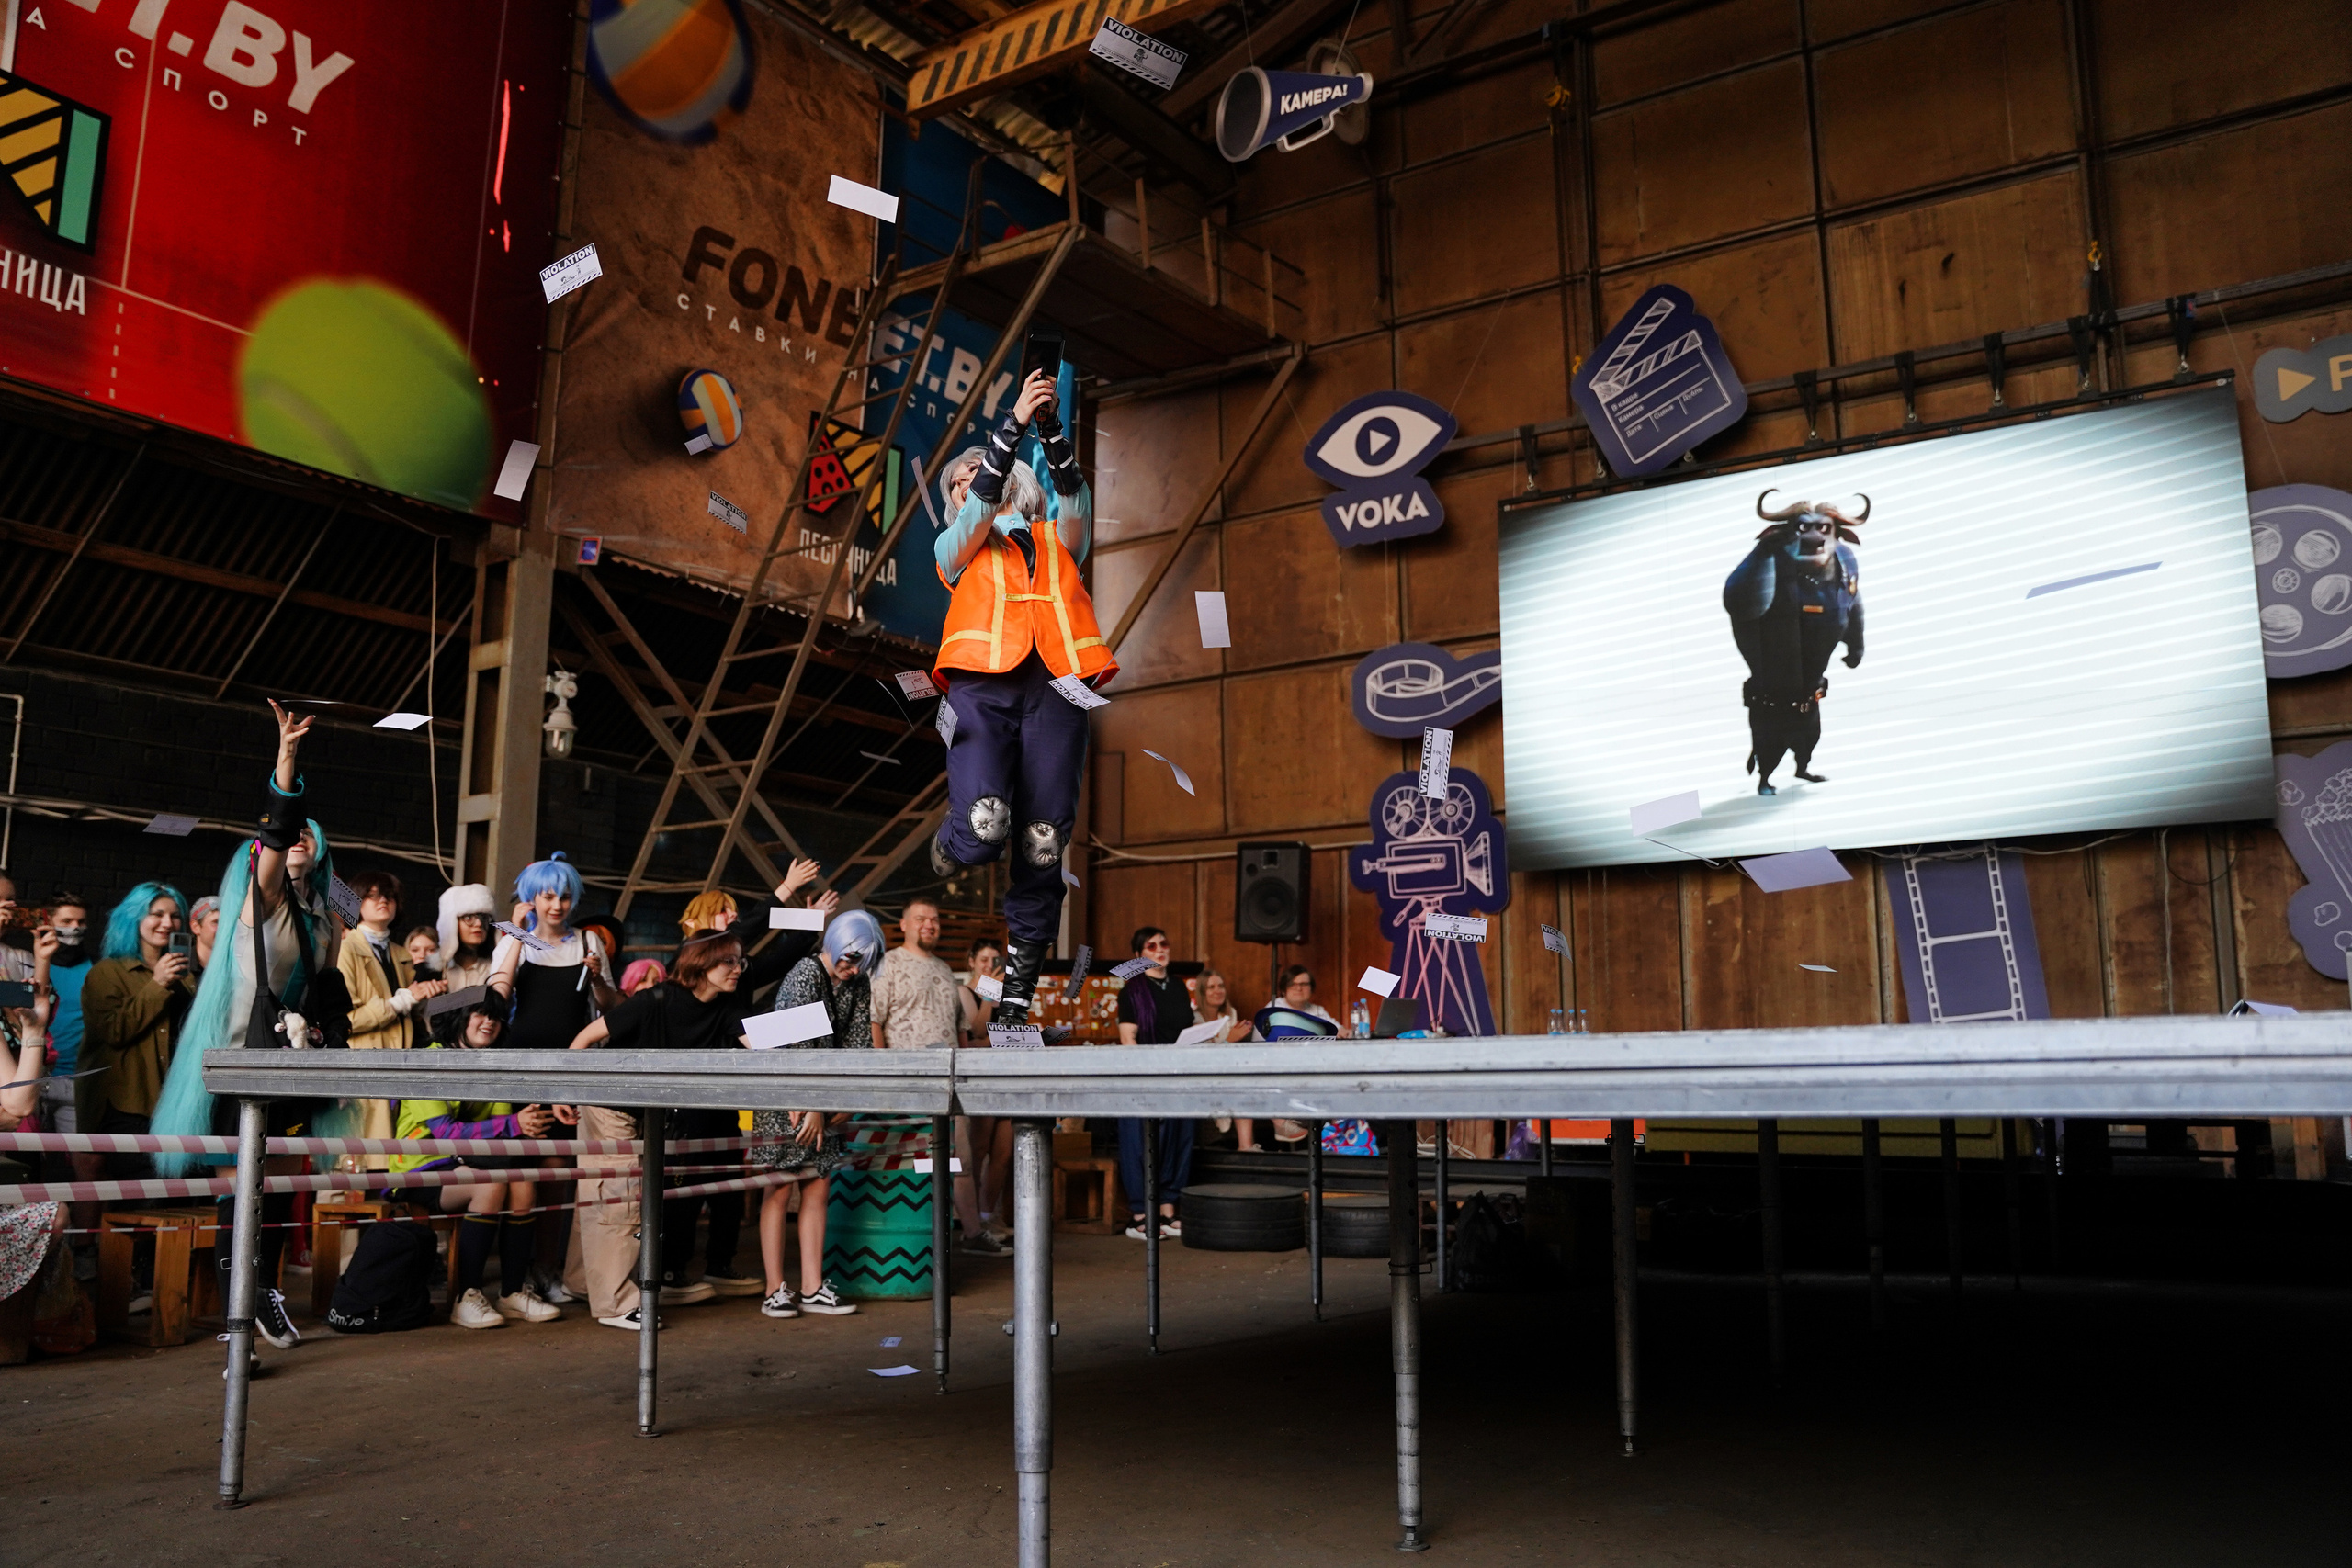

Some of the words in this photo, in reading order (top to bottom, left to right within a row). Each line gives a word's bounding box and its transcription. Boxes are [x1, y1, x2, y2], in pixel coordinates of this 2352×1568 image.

[1108, 19, 1184, 64] VIOLATION
[114, 47, 308, 147] СПОРТ
[1280, 83, 1348, 116] КАМЕРА!
[542, 245, 594, 280] VIOLATION
[677, 293, 817, 365] СТАВКИ
[712, 492, 746, 519] VIOLATION
[1335, 490, 1430, 532] VOKA
[1419, 729, 1433, 794] VIOLATION
[1427, 930, 1484, 942] VIOLATION
[989, 1023, 1037, 1032] VIOLATION
